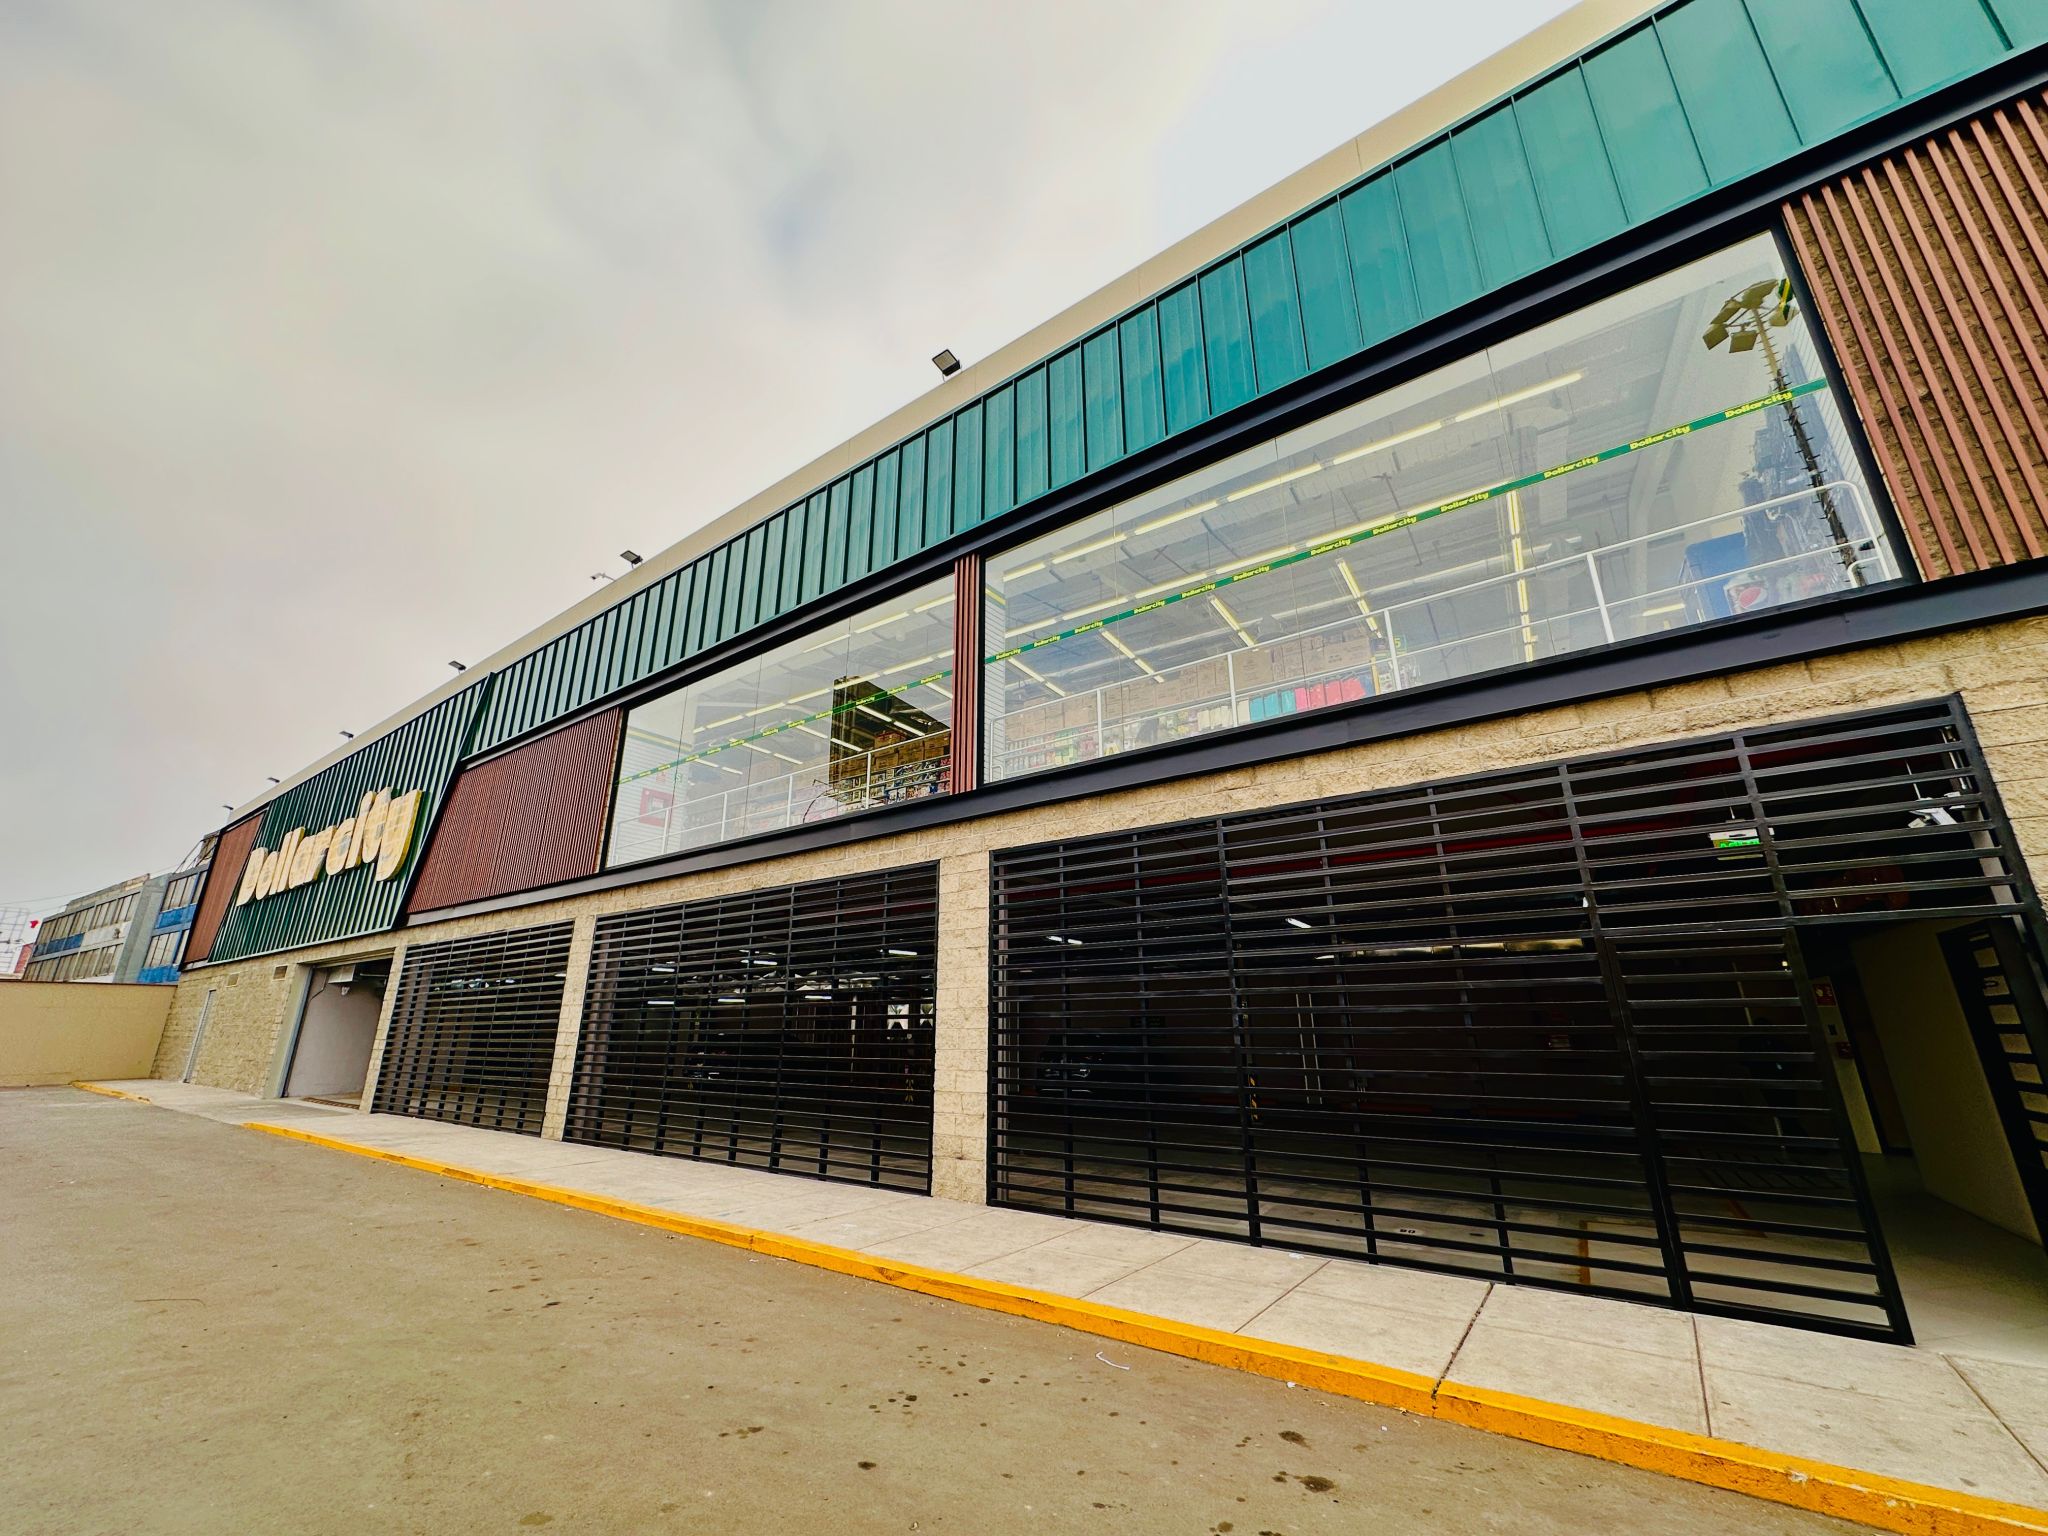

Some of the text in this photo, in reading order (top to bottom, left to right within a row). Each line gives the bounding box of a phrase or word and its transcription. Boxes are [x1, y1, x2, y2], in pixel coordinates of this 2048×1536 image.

[1074, 620, 1104, 634] Dollarcity
[1133, 600, 1165, 615] Dollarcity
[1181, 583, 1216, 598] Dollarcity
[1233, 564, 1270, 581] Dollarcity
[1310, 537, 1351, 555] Dollarcity
[1372, 515, 1417, 535] Dollarcity
[1440, 491, 1489, 513] Dollarcity
[1543, 455, 1599, 479] Dollarcity
[1630, 425, 1691, 451] Dollarcity
[1725, 391, 1792, 418] Dollarcity
[236, 787, 422, 907] Dollarcity
